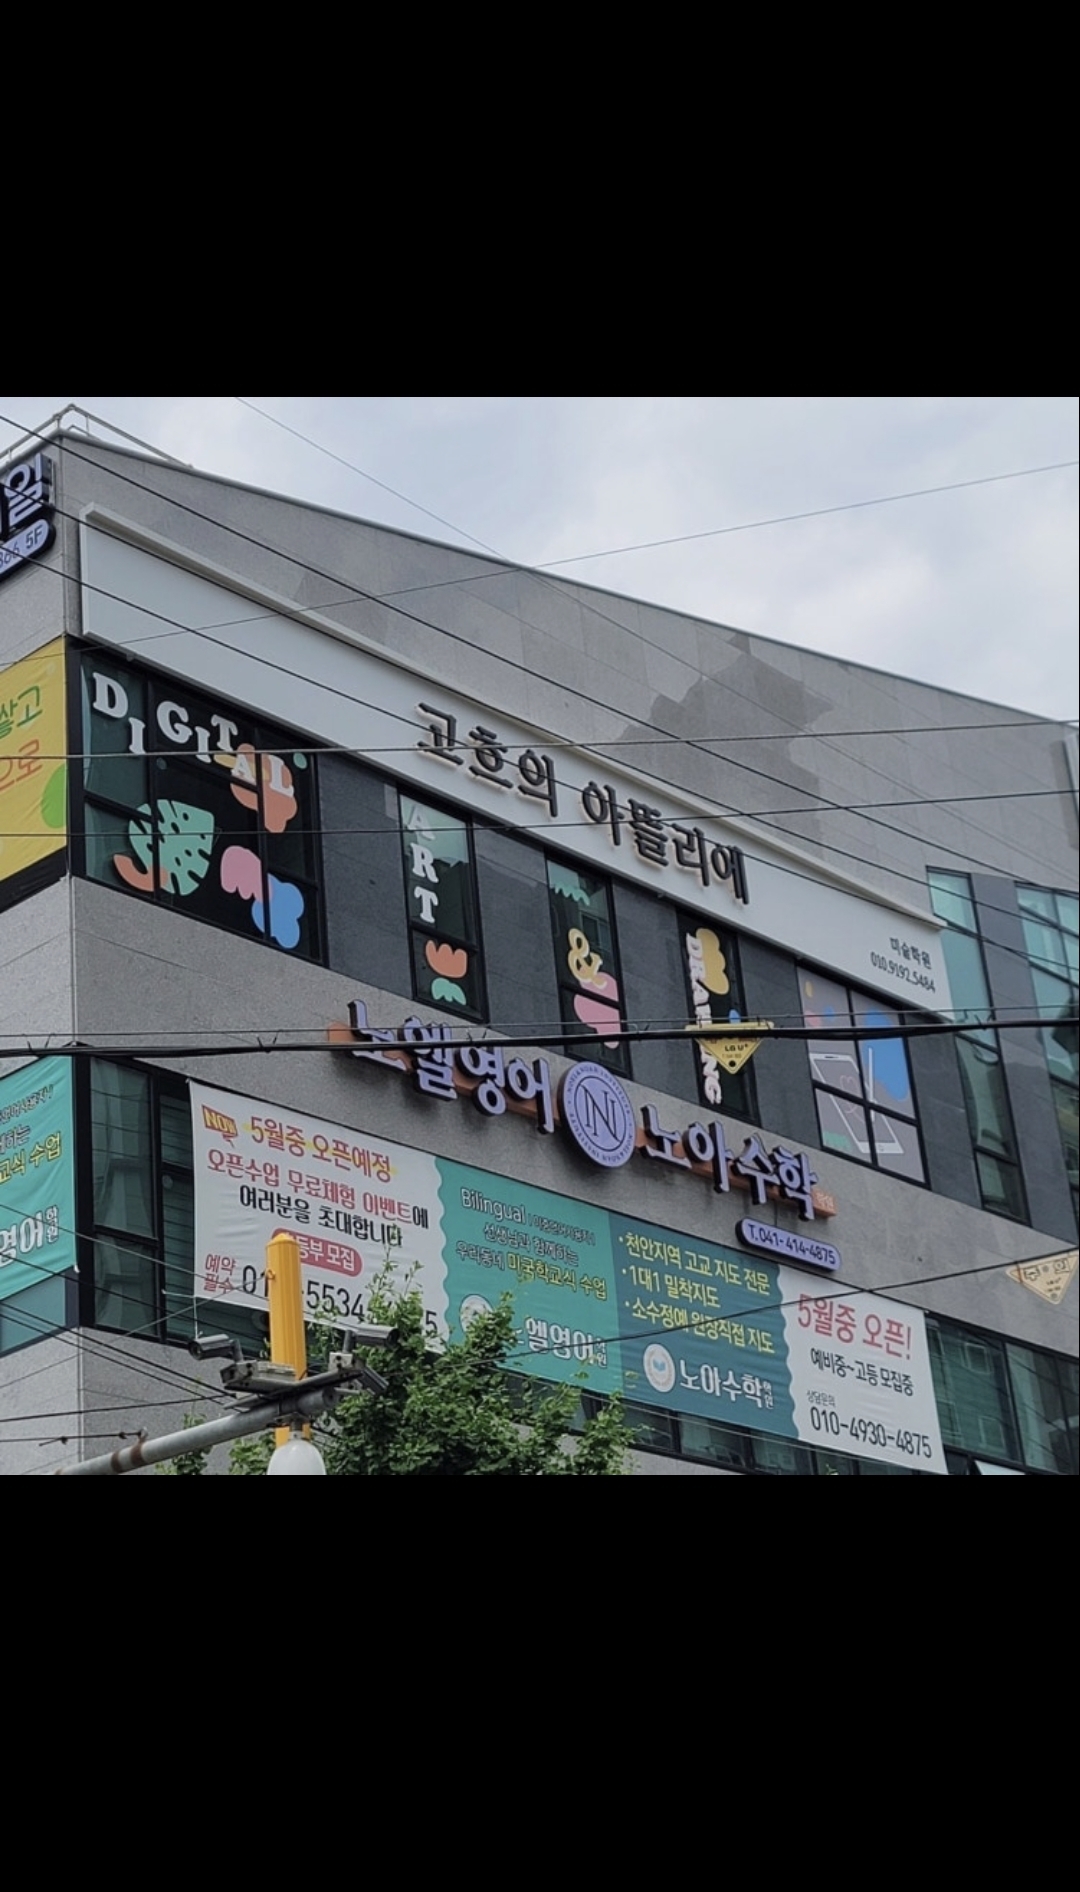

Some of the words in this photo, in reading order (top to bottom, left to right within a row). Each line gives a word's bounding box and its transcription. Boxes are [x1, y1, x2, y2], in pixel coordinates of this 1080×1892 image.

[26, 524, 42, 550] 5F
[93, 671, 294, 798] DIGITAL
[418, 702, 557, 818] 고흐의
[581, 779, 749, 905] 아뜰리에
[408, 804, 439, 923] ART
[568, 928, 607, 989] &
[350, 1000, 554, 1133] 노엘영어
[29, 1132, 61, 1167] 수업
[250, 1116, 304, 1157] 5월중
[311, 1134, 391, 1184] 오픈예정
[643, 1104, 819, 1220] 노아수학
[207, 1149, 280, 1188] 오픈수업
[287, 1169, 355, 1210] 무료체험
[363, 1191, 429, 1229] 이벤트에
[239, 1184, 311, 1224] 여러분을
[318, 1206, 402, 1247] 초대합니다
[461, 1189, 526, 1223] Bilingual
[205, 1253, 236, 1275] 예약
[327, 1244, 354, 1271] 모집
[484, 1223, 531, 1252] 선생님과
[626, 1233, 682, 1269] 천안지역
[685, 1250, 712, 1277] 고교
[715, 1259, 742, 1285] 지도
[744, 1268, 770, 1295] 전문
[203, 1273, 234, 1294] 필수
[456, 1241, 505, 1270] 우리동네
[580, 1275, 607, 1300] 수업
[629, 1265, 660, 1292] 1대1
[664, 1275, 720, 1308] 밀착지도
[632, 1297, 689, 1333] 소수정예
[691, 1311, 746, 1348] 원장직접
[748, 1327, 775, 1354] 지도
[798, 1293, 857, 1344] 5월중
[862, 1314, 911, 1360] 오픈!
[679, 1359, 763, 1408] 노아수학
[880, 1367, 914, 1397] 모집중
[810, 1406, 932, 1458] 010-4930-4875
